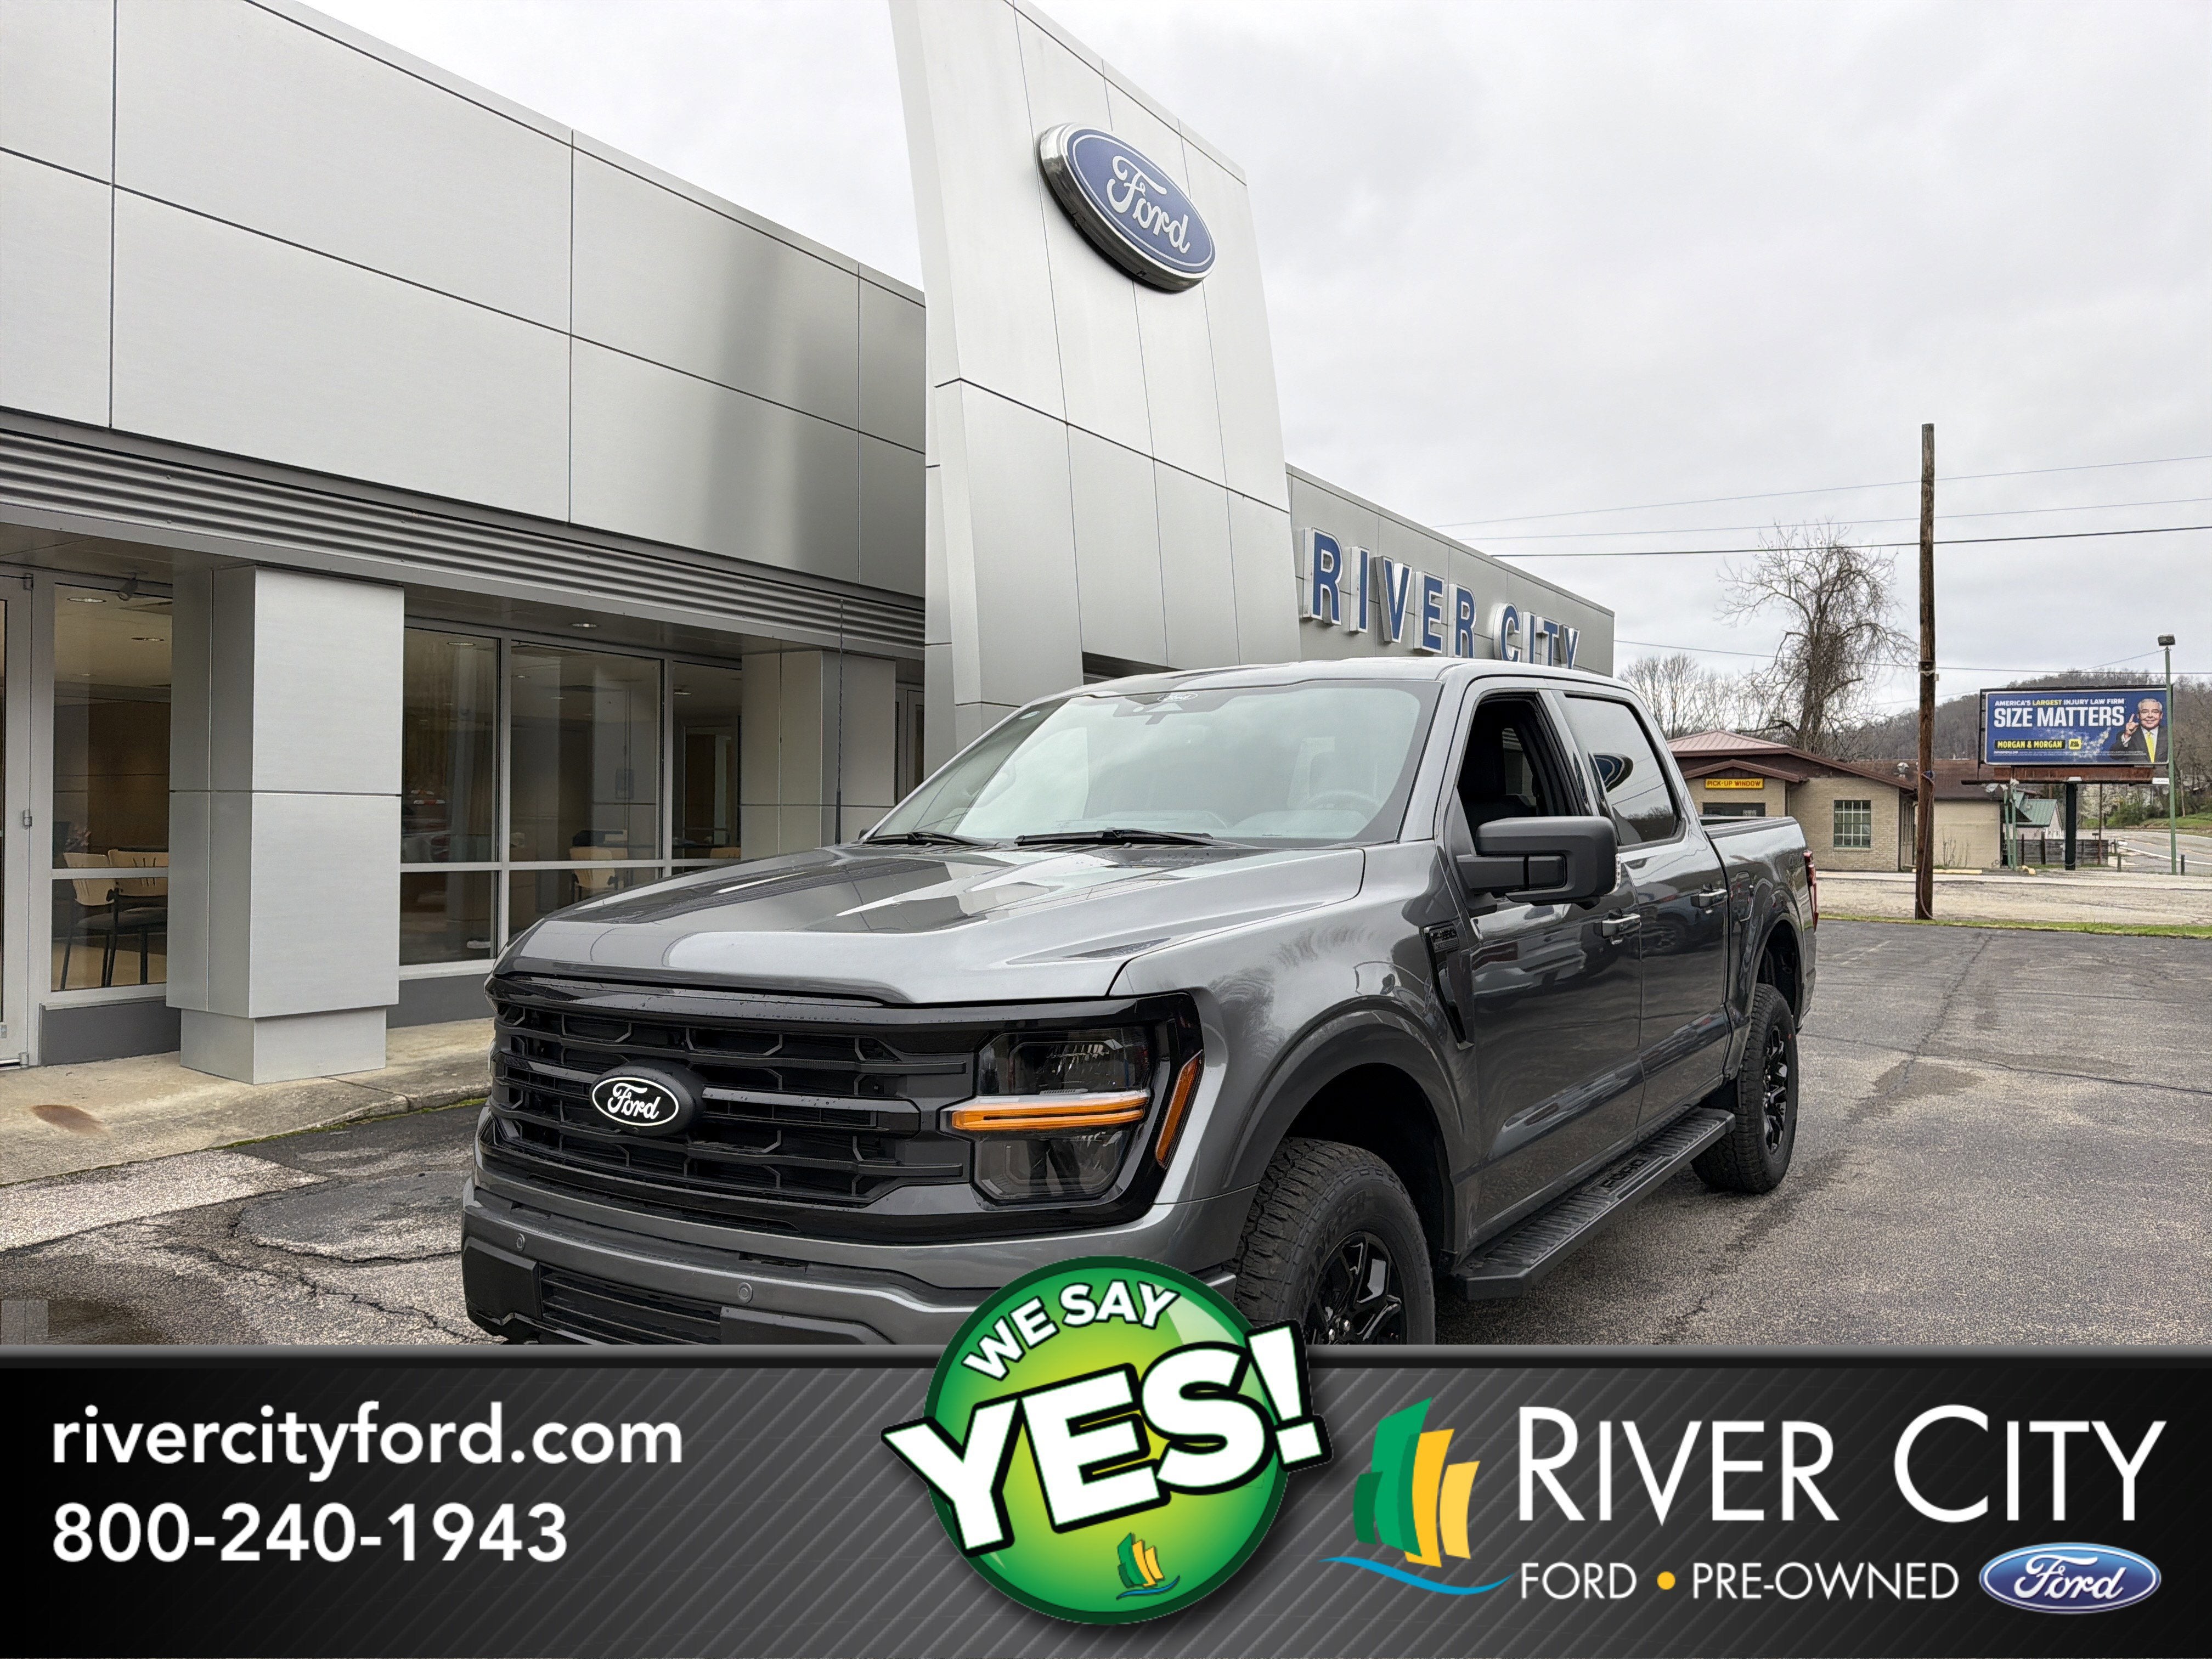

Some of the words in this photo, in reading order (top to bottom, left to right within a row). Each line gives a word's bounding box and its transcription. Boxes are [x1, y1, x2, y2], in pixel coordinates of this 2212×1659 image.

[1107, 155, 1190, 254] Ford
[1305, 527, 1476, 658] RIVER
[1496, 602, 1579, 669] CITY
[1994, 708, 2033, 727] SIZE
[2037, 706, 2125, 726] MATTERS
[607, 1082, 661, 1119] Ford
[1599, 1159, 1647, 1188] FORD
